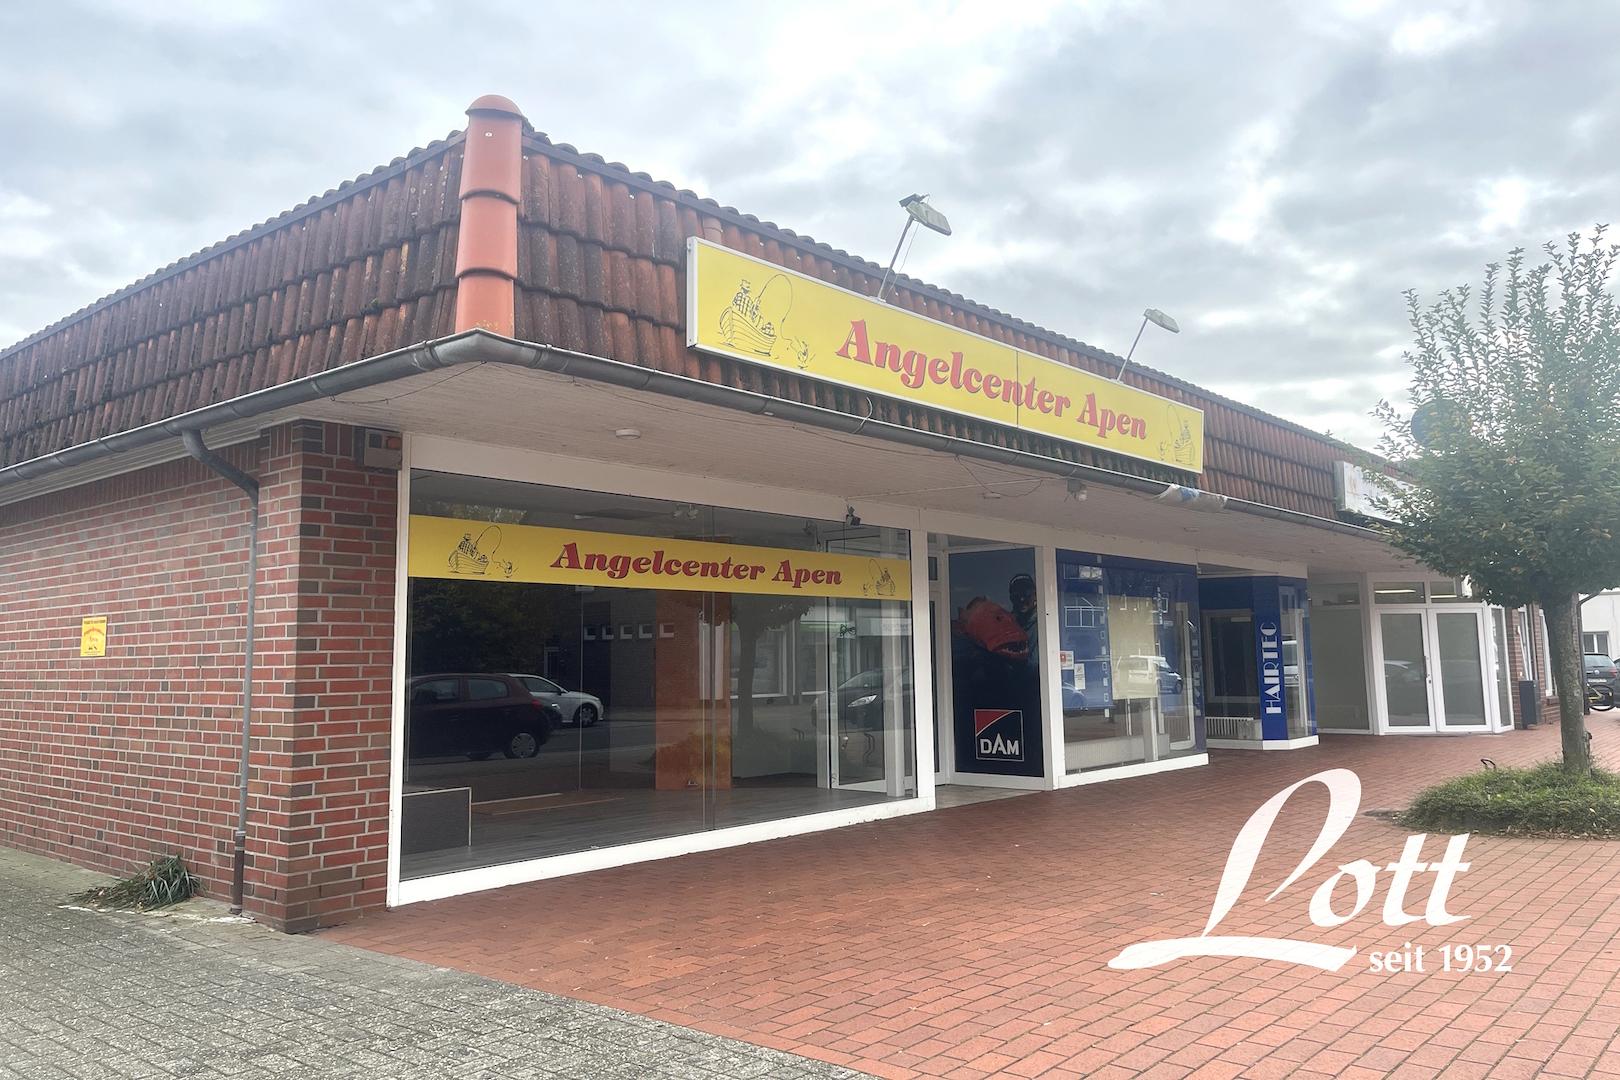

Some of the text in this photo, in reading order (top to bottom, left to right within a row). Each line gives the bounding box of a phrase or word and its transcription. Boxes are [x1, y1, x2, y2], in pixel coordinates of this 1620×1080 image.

[836, 319, 1148, 440] Angelcenter Apen
[550, 542, 843, 588] Angelcenter Apen
[1260, 622, 1282, 714] HAIRTEC
[980, 733, 1020, 756] DAM
